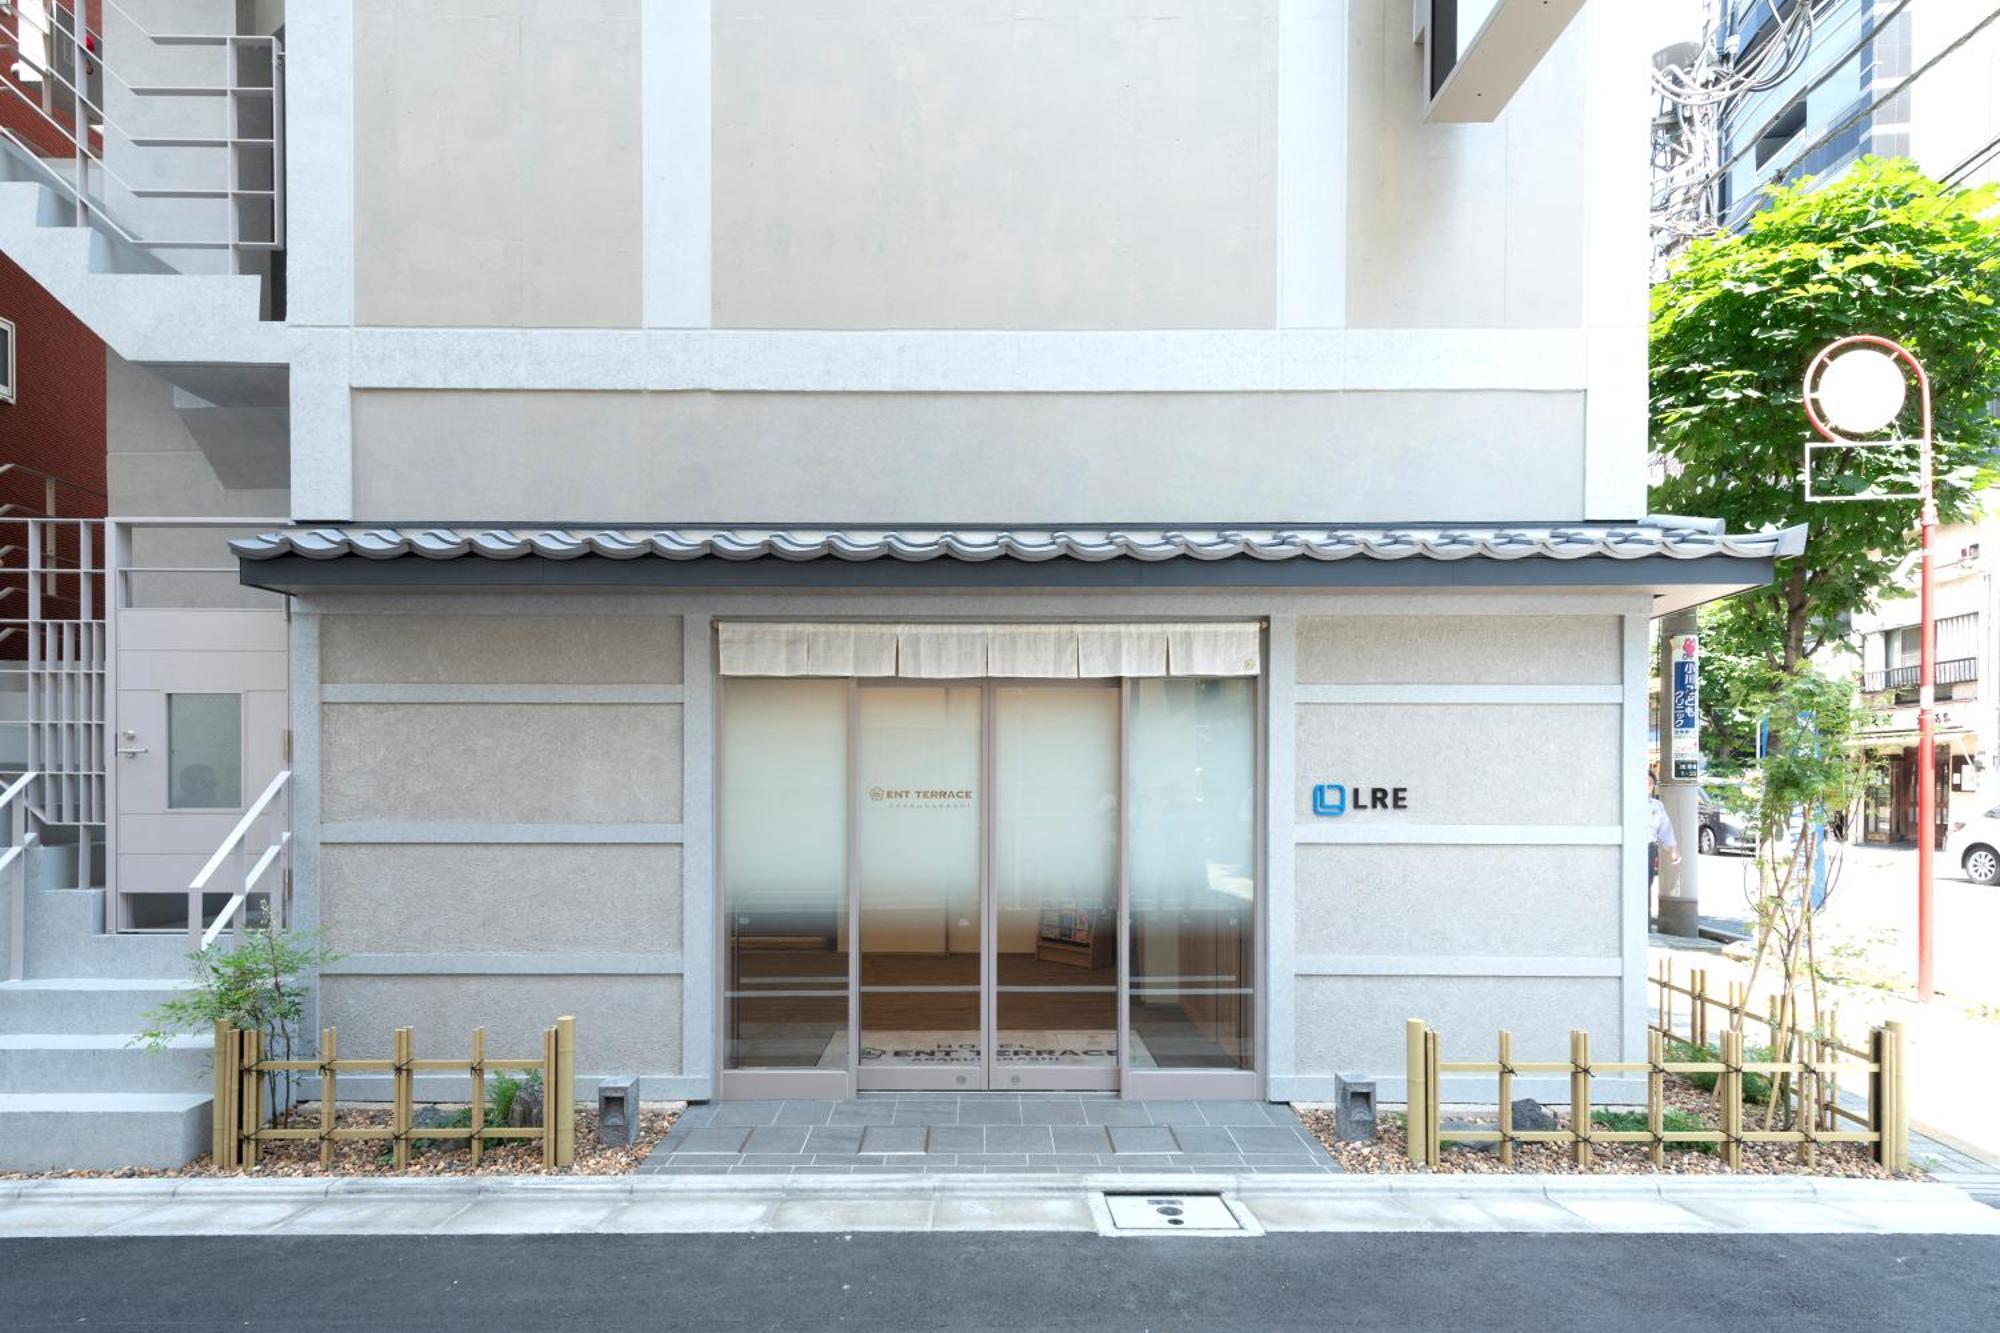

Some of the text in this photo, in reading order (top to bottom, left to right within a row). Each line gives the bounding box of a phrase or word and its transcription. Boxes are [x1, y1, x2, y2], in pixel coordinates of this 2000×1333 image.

[1675, 690, 1685, 728] クリニック
[886, 790, 973, 799] ENT TERRACE
[1353, 787, 1408, 809] LRE
[893, 1049, 958, 1057] ENT
